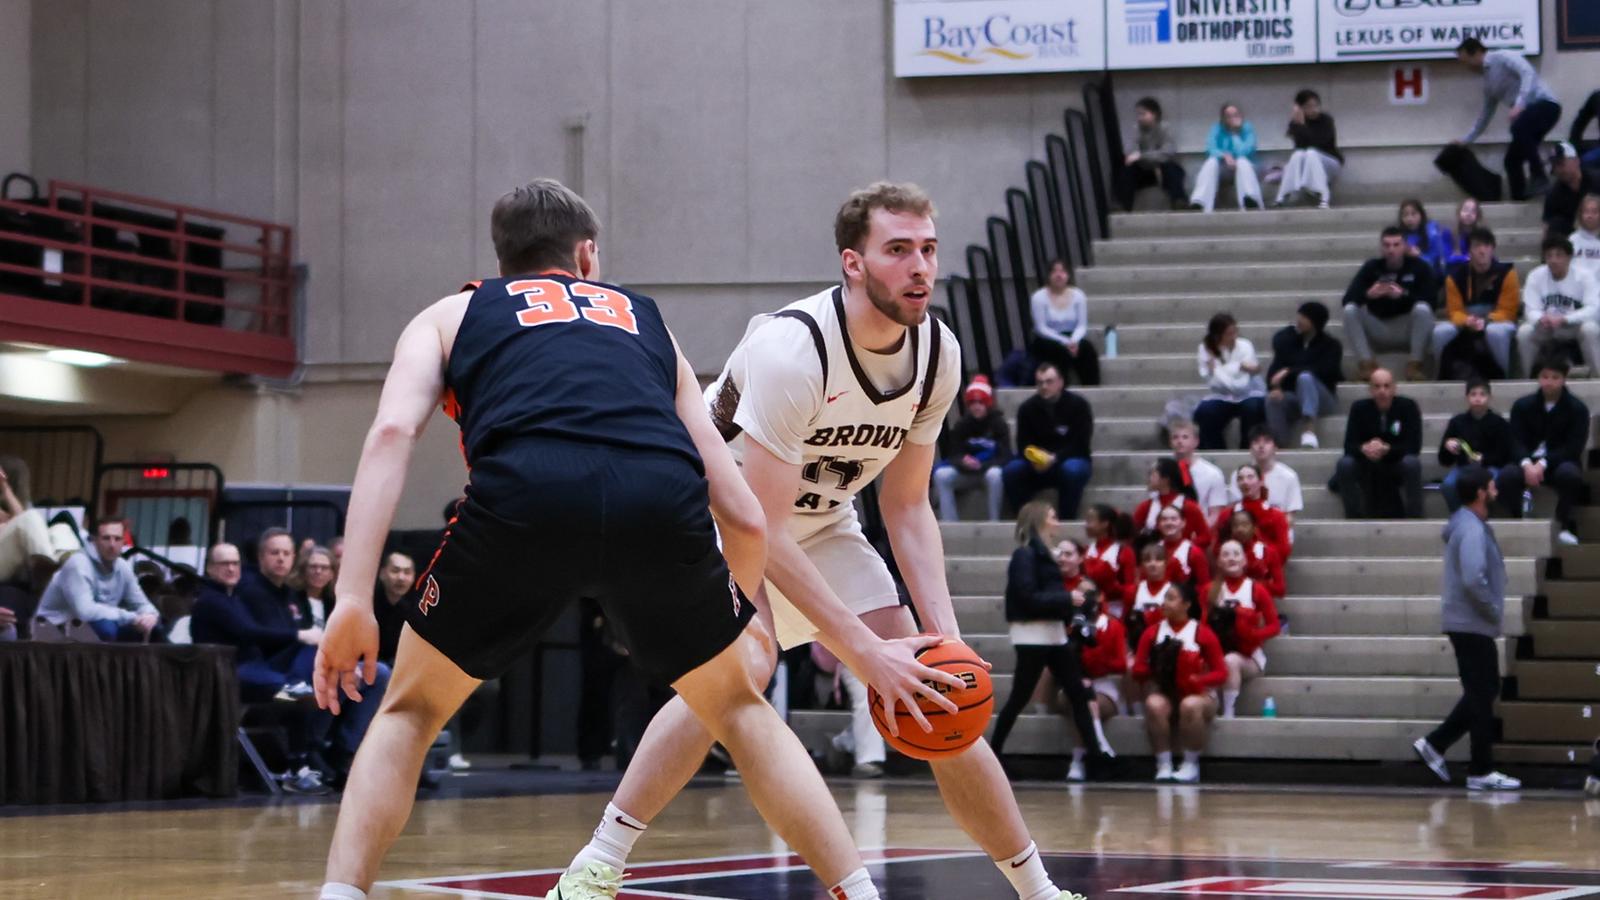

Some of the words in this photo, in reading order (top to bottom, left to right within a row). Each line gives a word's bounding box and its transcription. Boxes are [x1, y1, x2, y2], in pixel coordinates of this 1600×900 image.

[1177, 0, 1291, 16] UNIVERSITY
[923, 14, 1078, 57] BayCoast
[1177, 18, 1293, 43] ORTHOPEDICS
[1335, 29, 1394, 46] LEXUS
[1400, 27, 1424, 44] OF
[1431, 24, 1524, 42] WARWICK
[1394, 68, 1423, 98] H
[505, 279, 640, 335] 33
[418, 574, 440, 616] P
